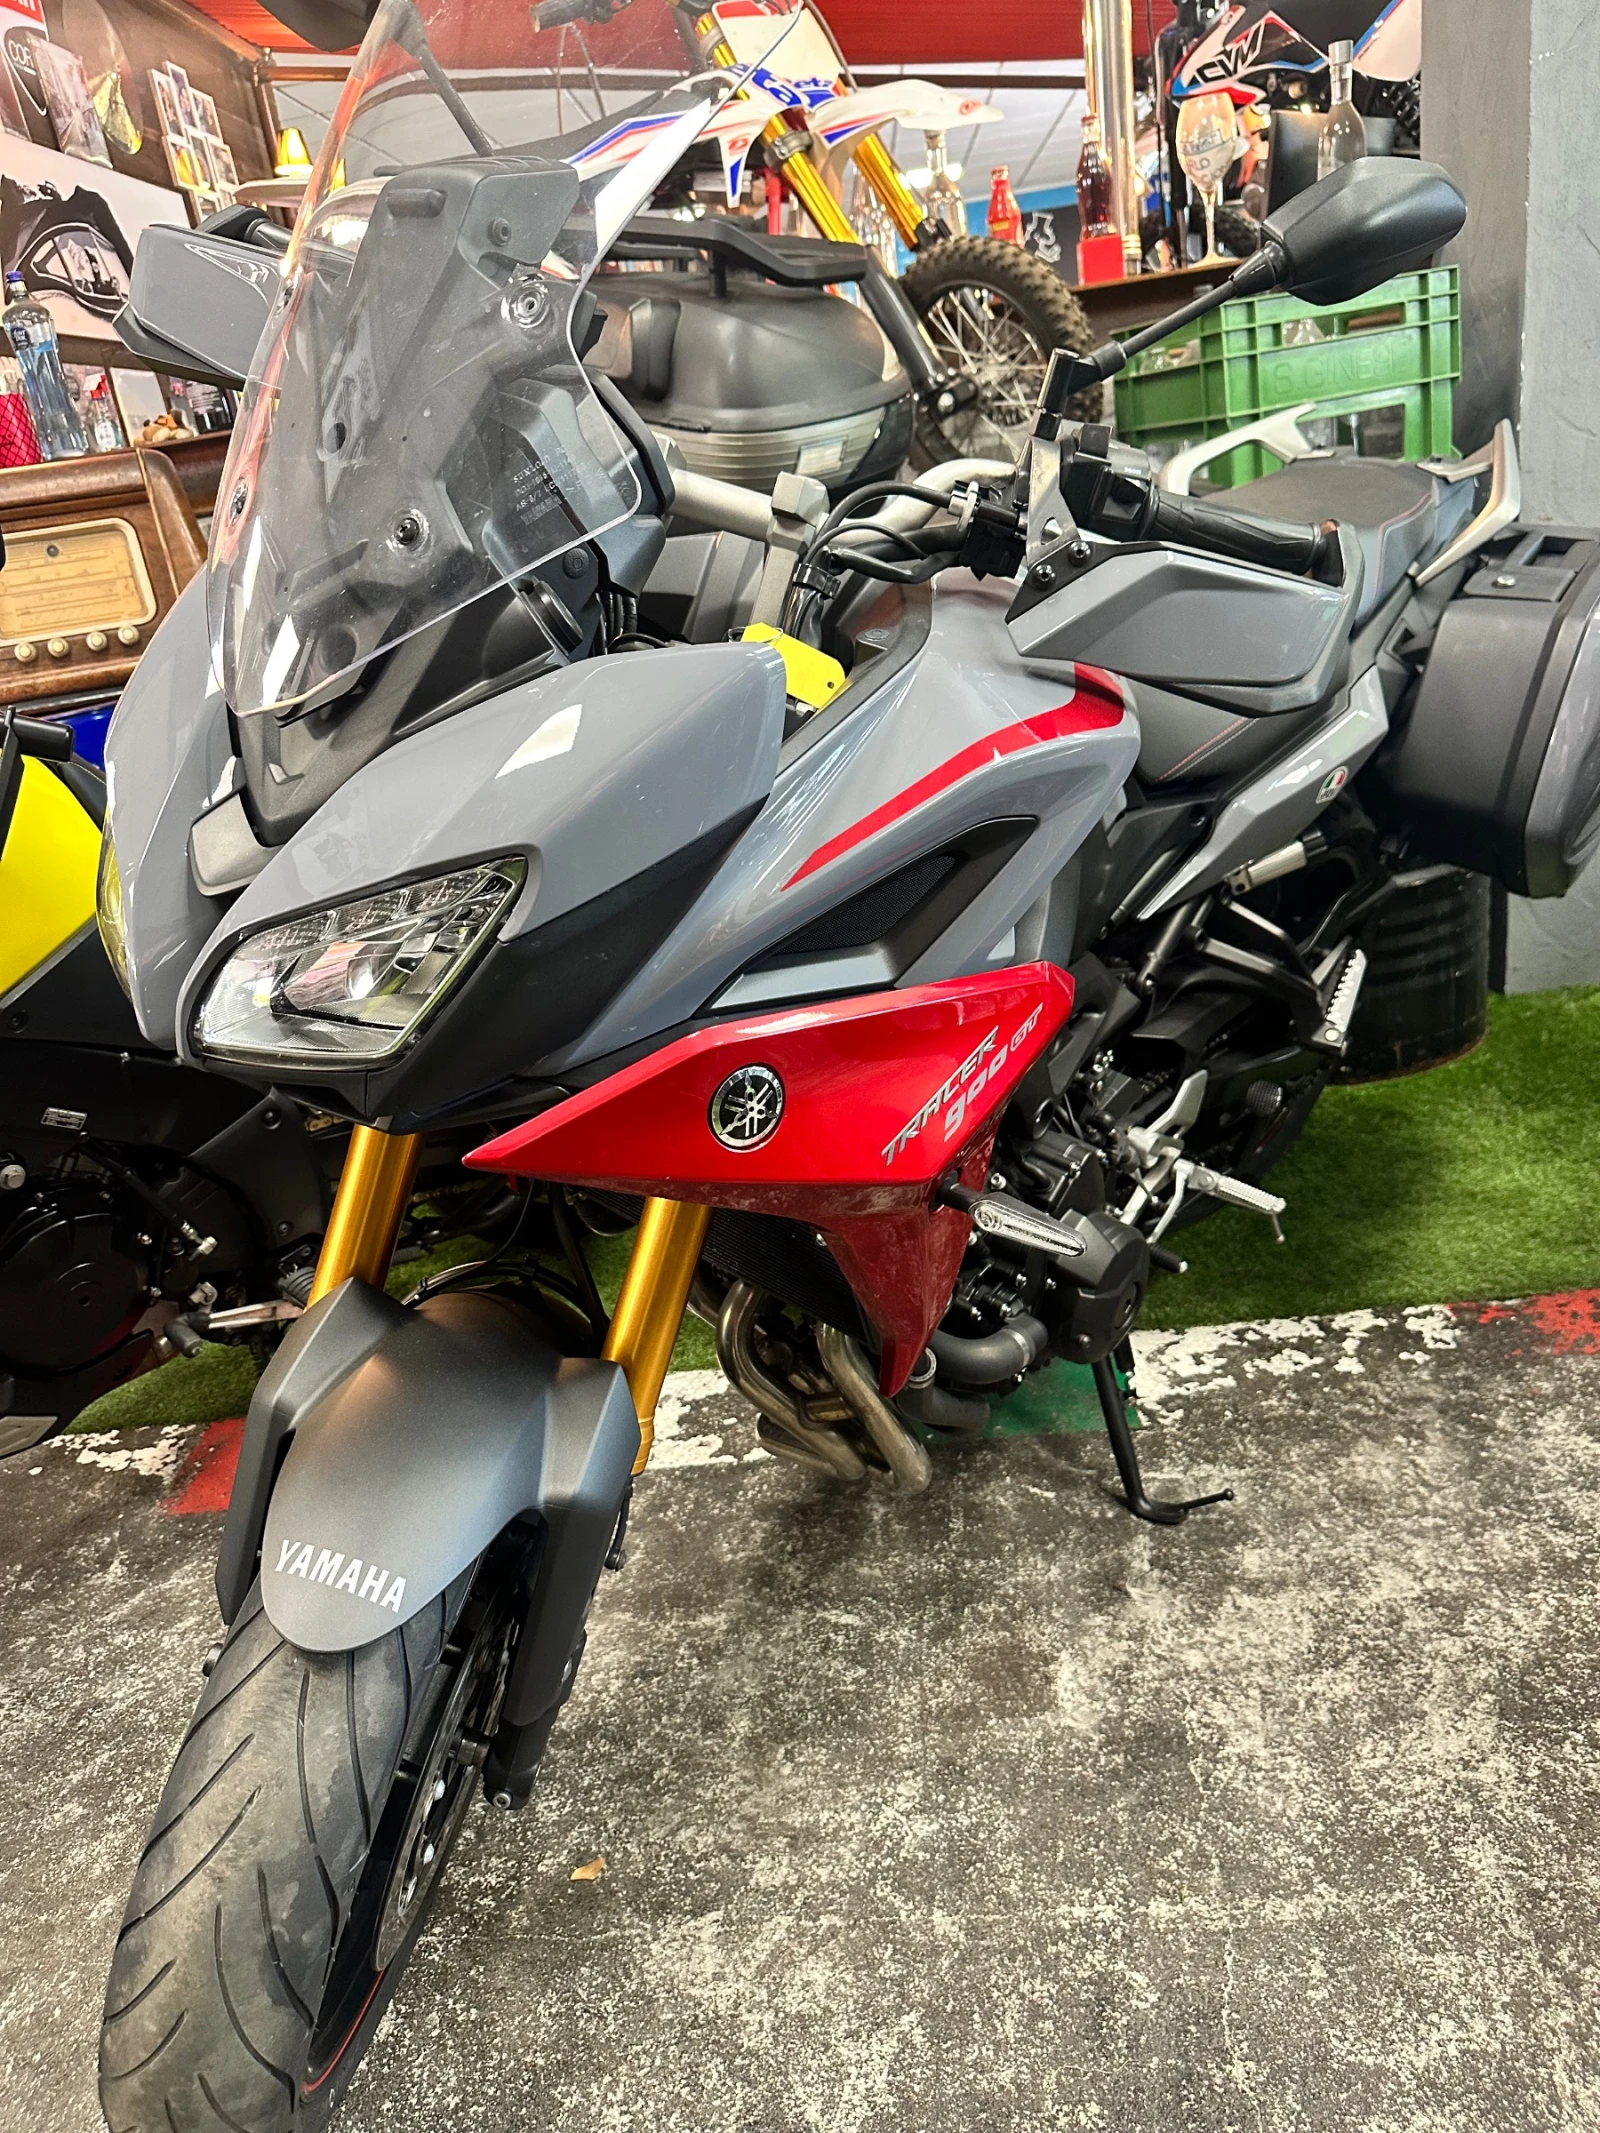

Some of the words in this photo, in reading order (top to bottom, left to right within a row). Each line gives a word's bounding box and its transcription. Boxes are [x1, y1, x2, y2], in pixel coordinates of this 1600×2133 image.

[881, 1026, 999, 1167] TRACER
[944, 1045, 1007, 1142] 900
[1010, 1003, 1044, 1052] GT
[275, 1539, 407, 1613] YAMAHA
